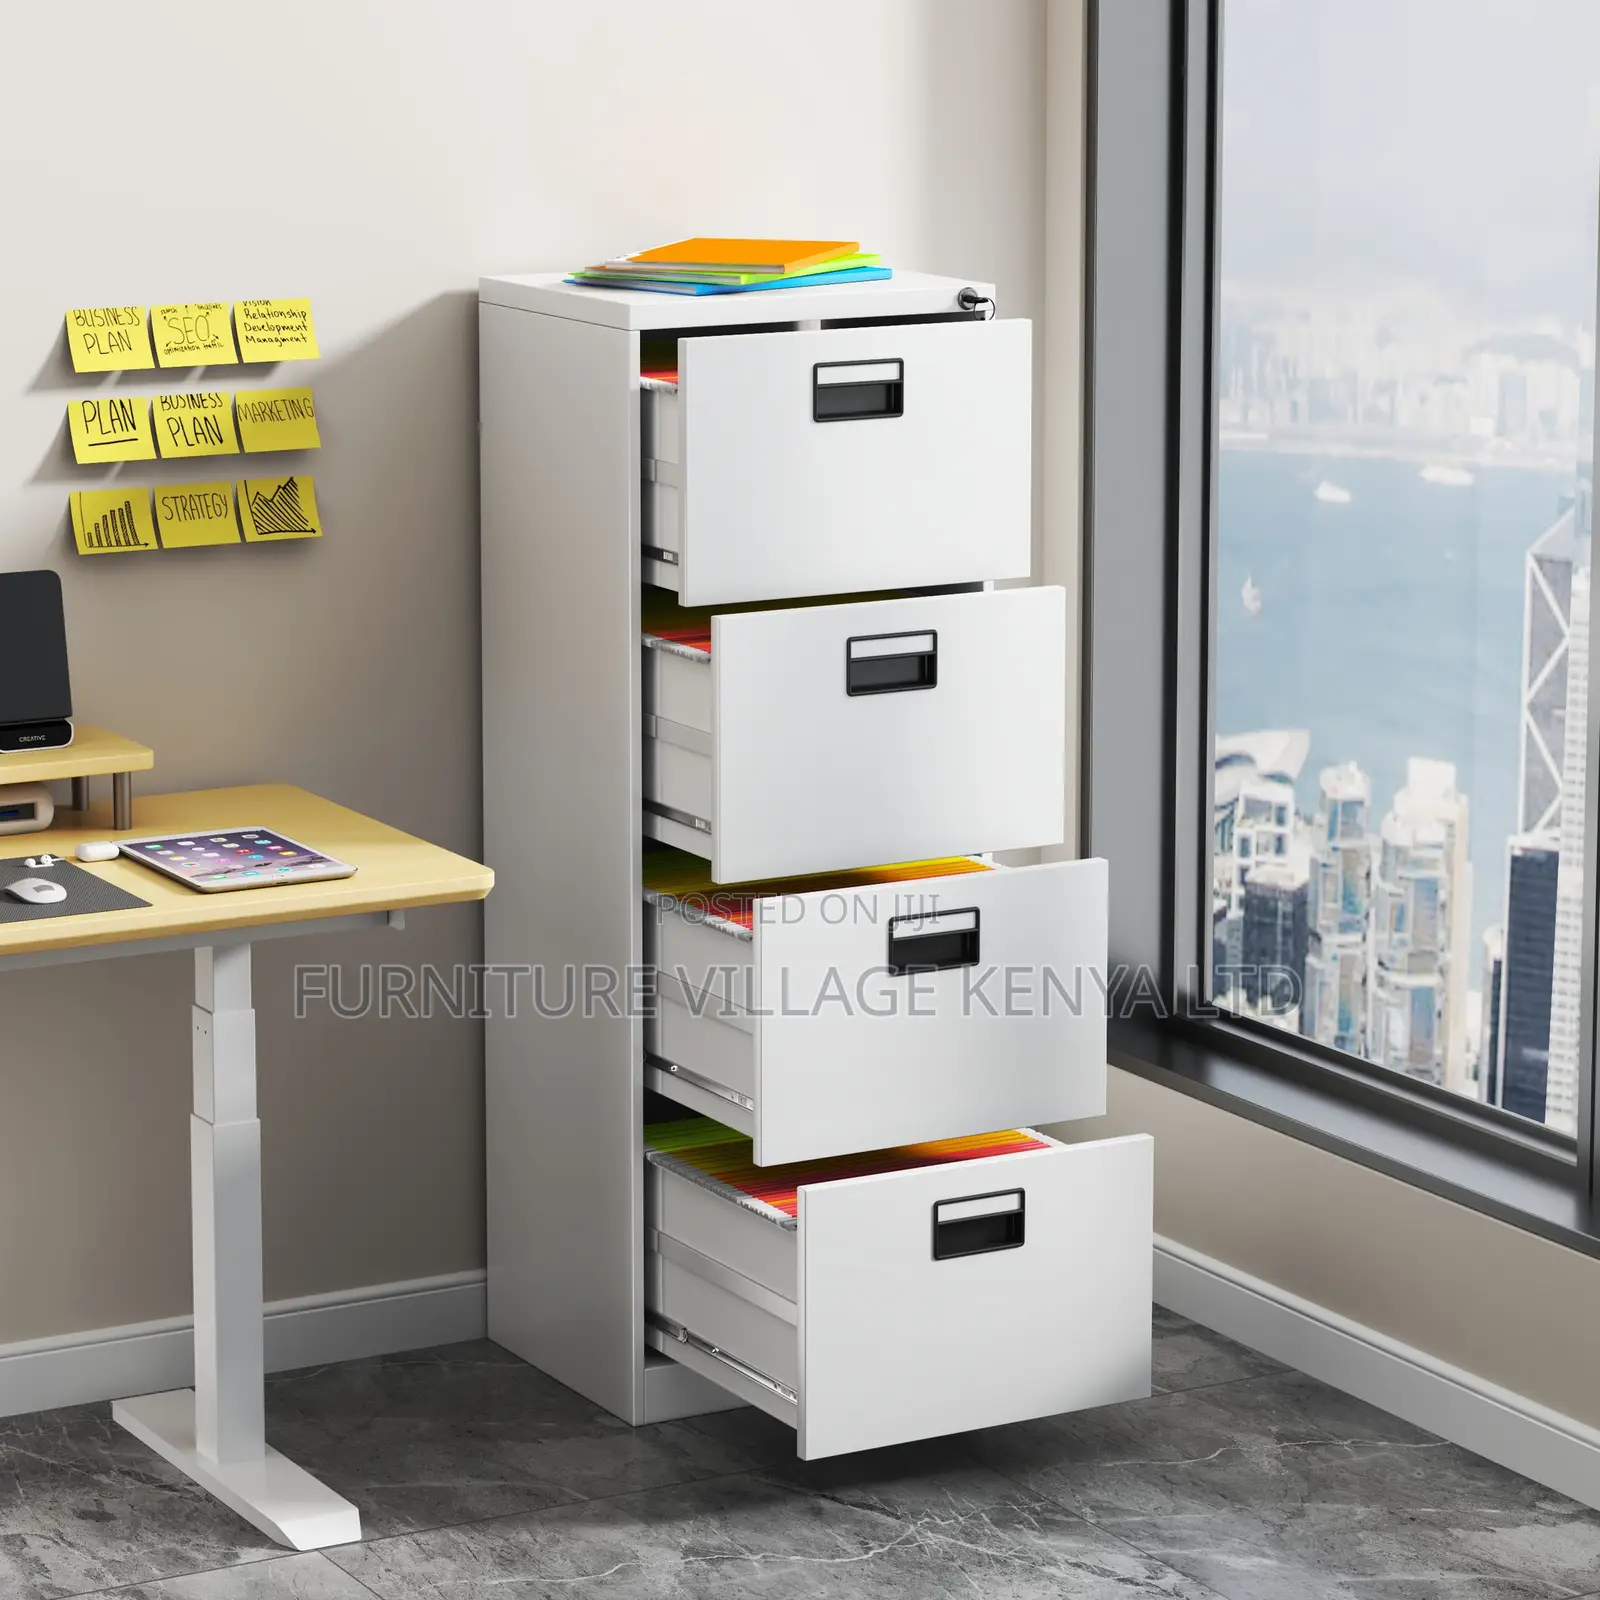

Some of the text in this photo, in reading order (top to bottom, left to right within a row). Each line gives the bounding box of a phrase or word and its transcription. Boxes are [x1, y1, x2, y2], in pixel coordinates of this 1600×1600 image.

[73, 306, 140, 327] BUSINESS
[244, 308, 307, 321] Relationship
[168, 315, 210, 345] SEO
[244, 321, 307, 335] Development
[245, 333, 307, 347] Managment
[83, 329, 132, 355] PLAN
[160, 392, 223, 411] BUSINESS
[237, 397, 315, 423] MARKETING
[82, 398, 137, 435] PLAN
[166, 414, 224, 447] PLAN
[162, 492, 228, 522] STRATEGY
